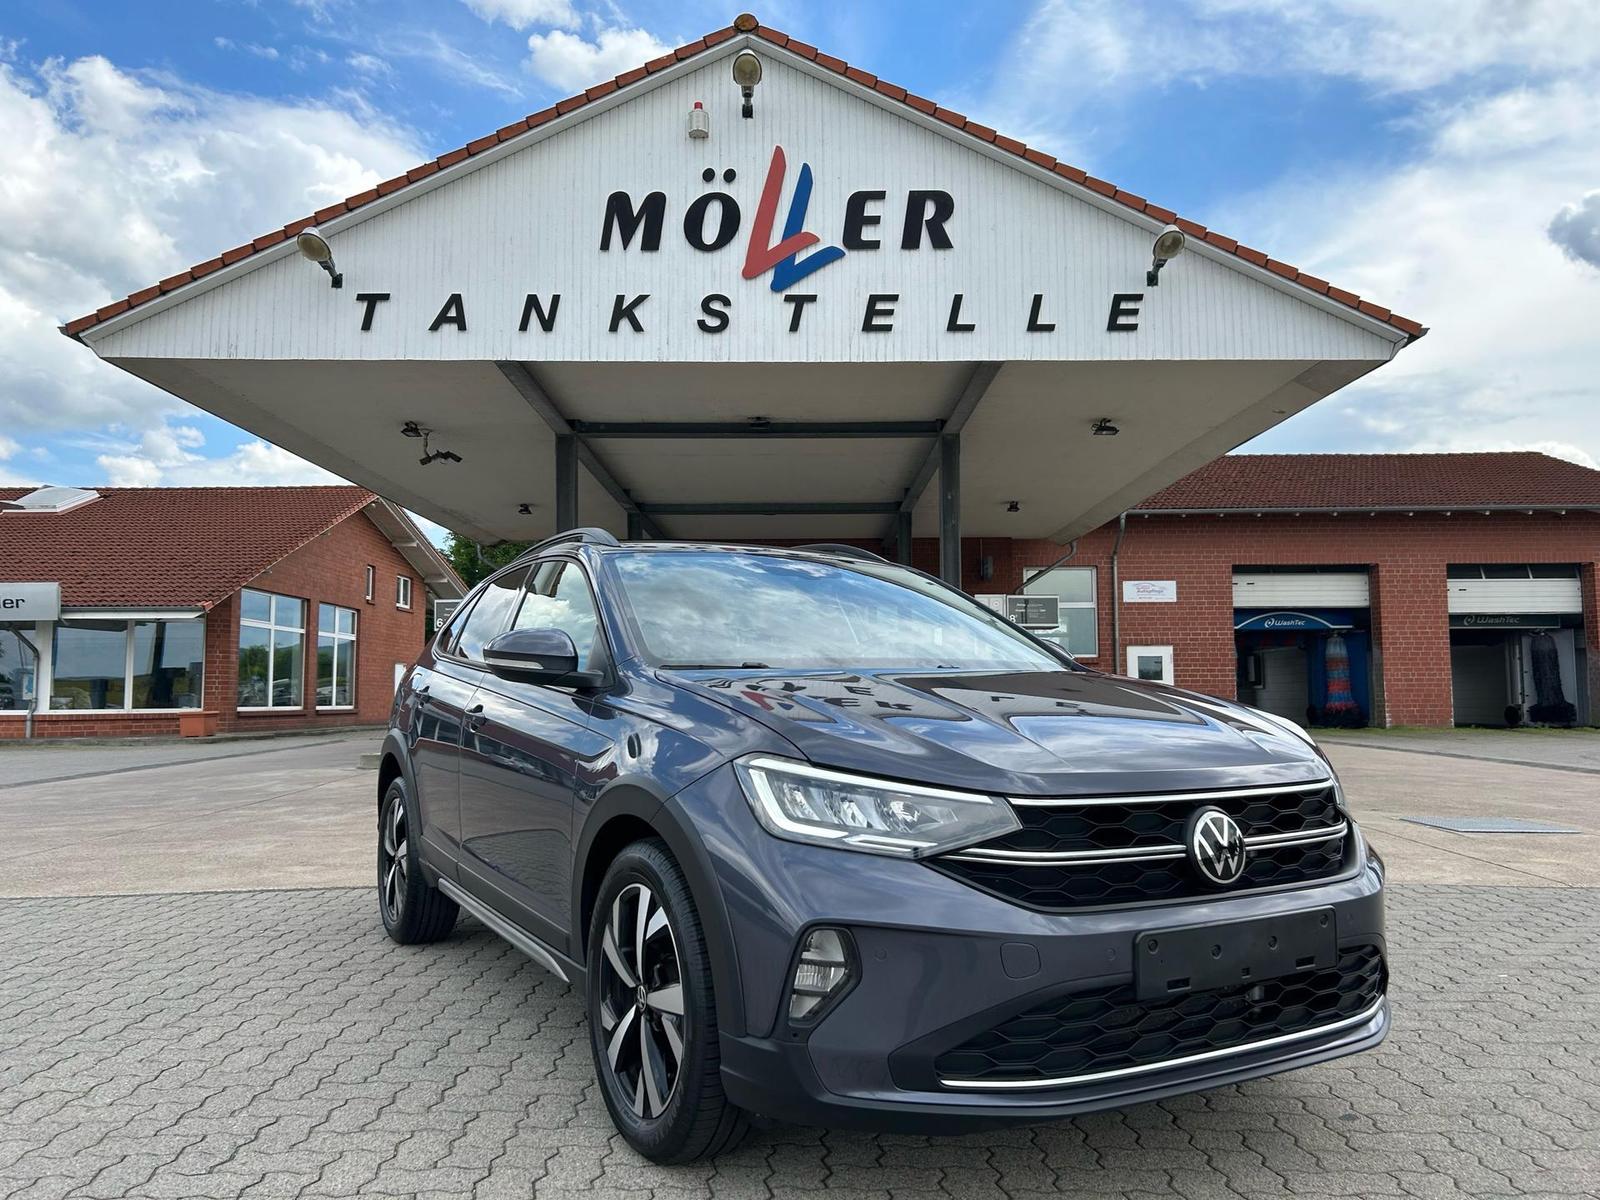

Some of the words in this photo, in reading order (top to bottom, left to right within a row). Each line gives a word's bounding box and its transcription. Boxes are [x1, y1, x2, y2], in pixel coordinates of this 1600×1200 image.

[600, 145, 955, 293] MÖLLER
[356, 293, 1144, 331] TANKSTELLE
[0, 597, 25, 609] er
